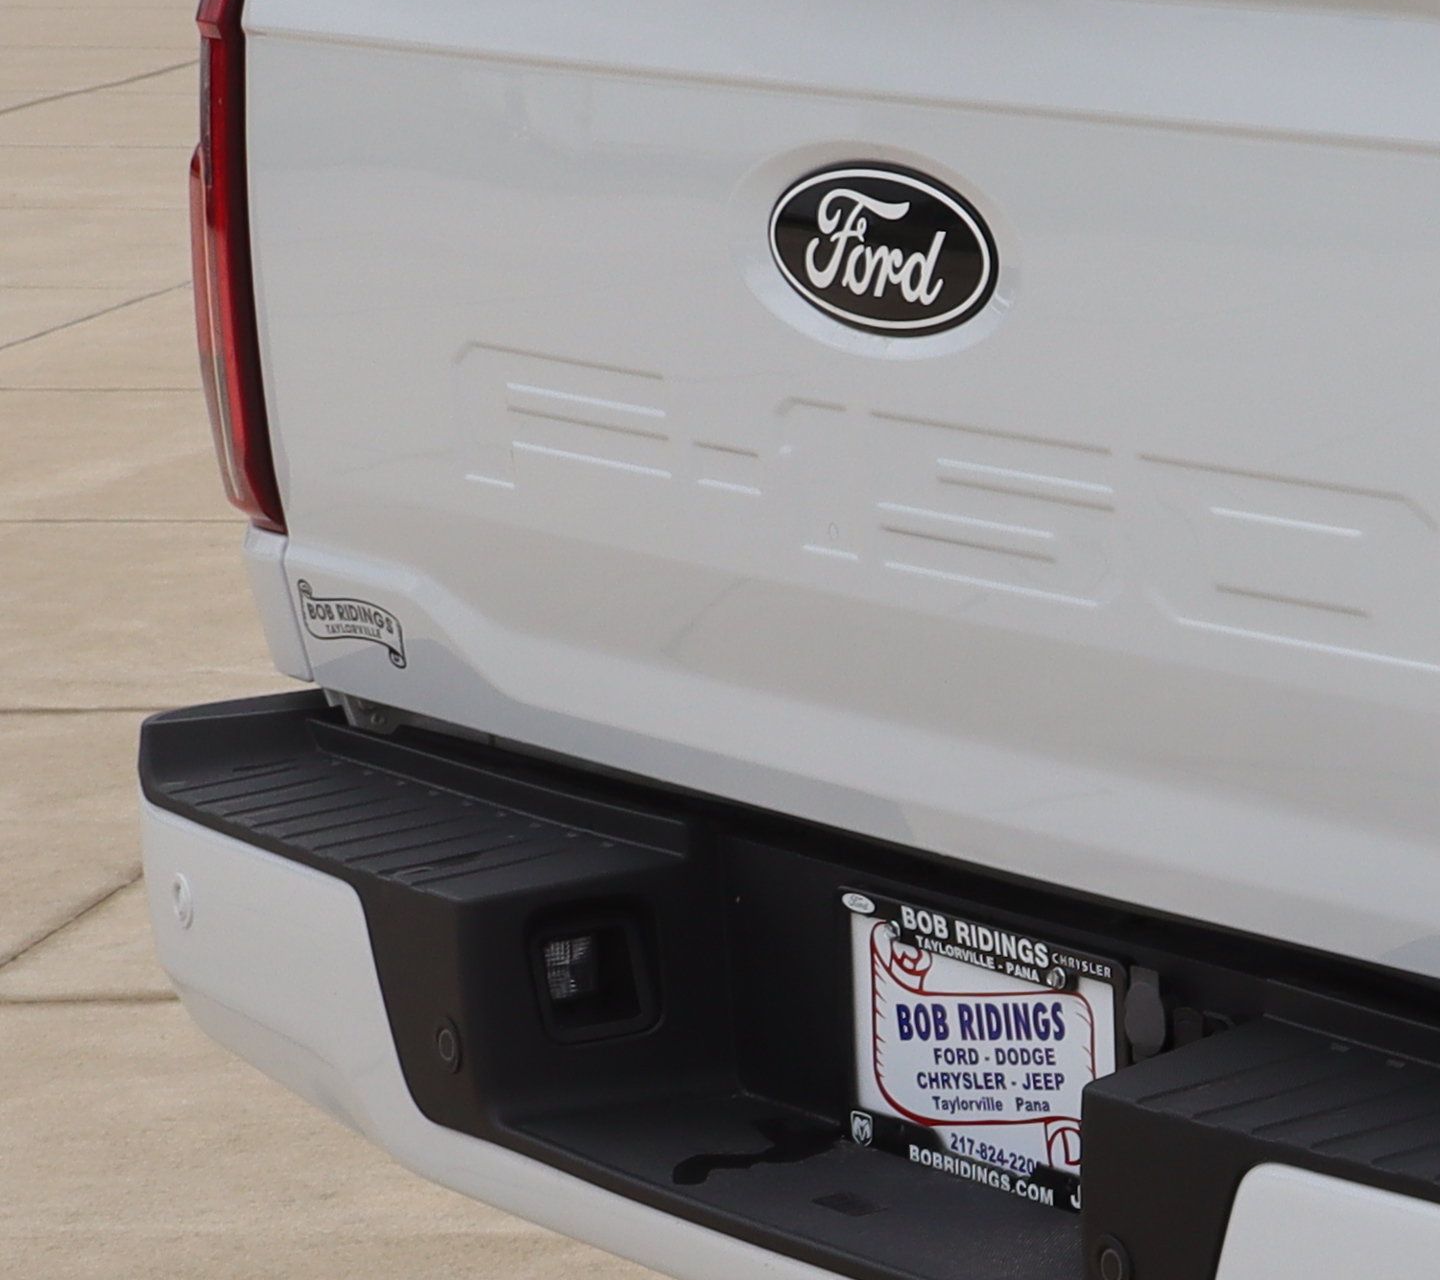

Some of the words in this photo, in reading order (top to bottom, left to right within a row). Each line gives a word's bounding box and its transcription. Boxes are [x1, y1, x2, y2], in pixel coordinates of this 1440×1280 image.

[805, 188, 946, 306] Ford
[307, 602, 335, 620] BOB
[335, 603, 394, 635] RIDINGS
[901, 905, 949, 941] BOB
[954, 919, 1050, 968] RIDINGS
[915, 935, 996, 970] TAYLORVILLE
[1006, 961, 1040, 983] PANA
[1051, 952, 1112, 979] CHRYSLER
[895, 1002, 950, 1042] BOB
[958, 1002, 1066, 1042] RIDINGS
[933, 1047, 980, 1066] FORD
[994, 1048, 1057, 1066] DODGE
[916, 1072, 1007, 1091] CHRYSLER
[1022, 1073, 1065, 1091] JEEP
[932, 1096, 1004, 1114] Taylorville
[1015, 1097, 1051, 1113] Pana
[950, 1132, 1038, 1176] 217-824-220
[909, 1144, 1054, 1207] BOBRIDINGS.COM
